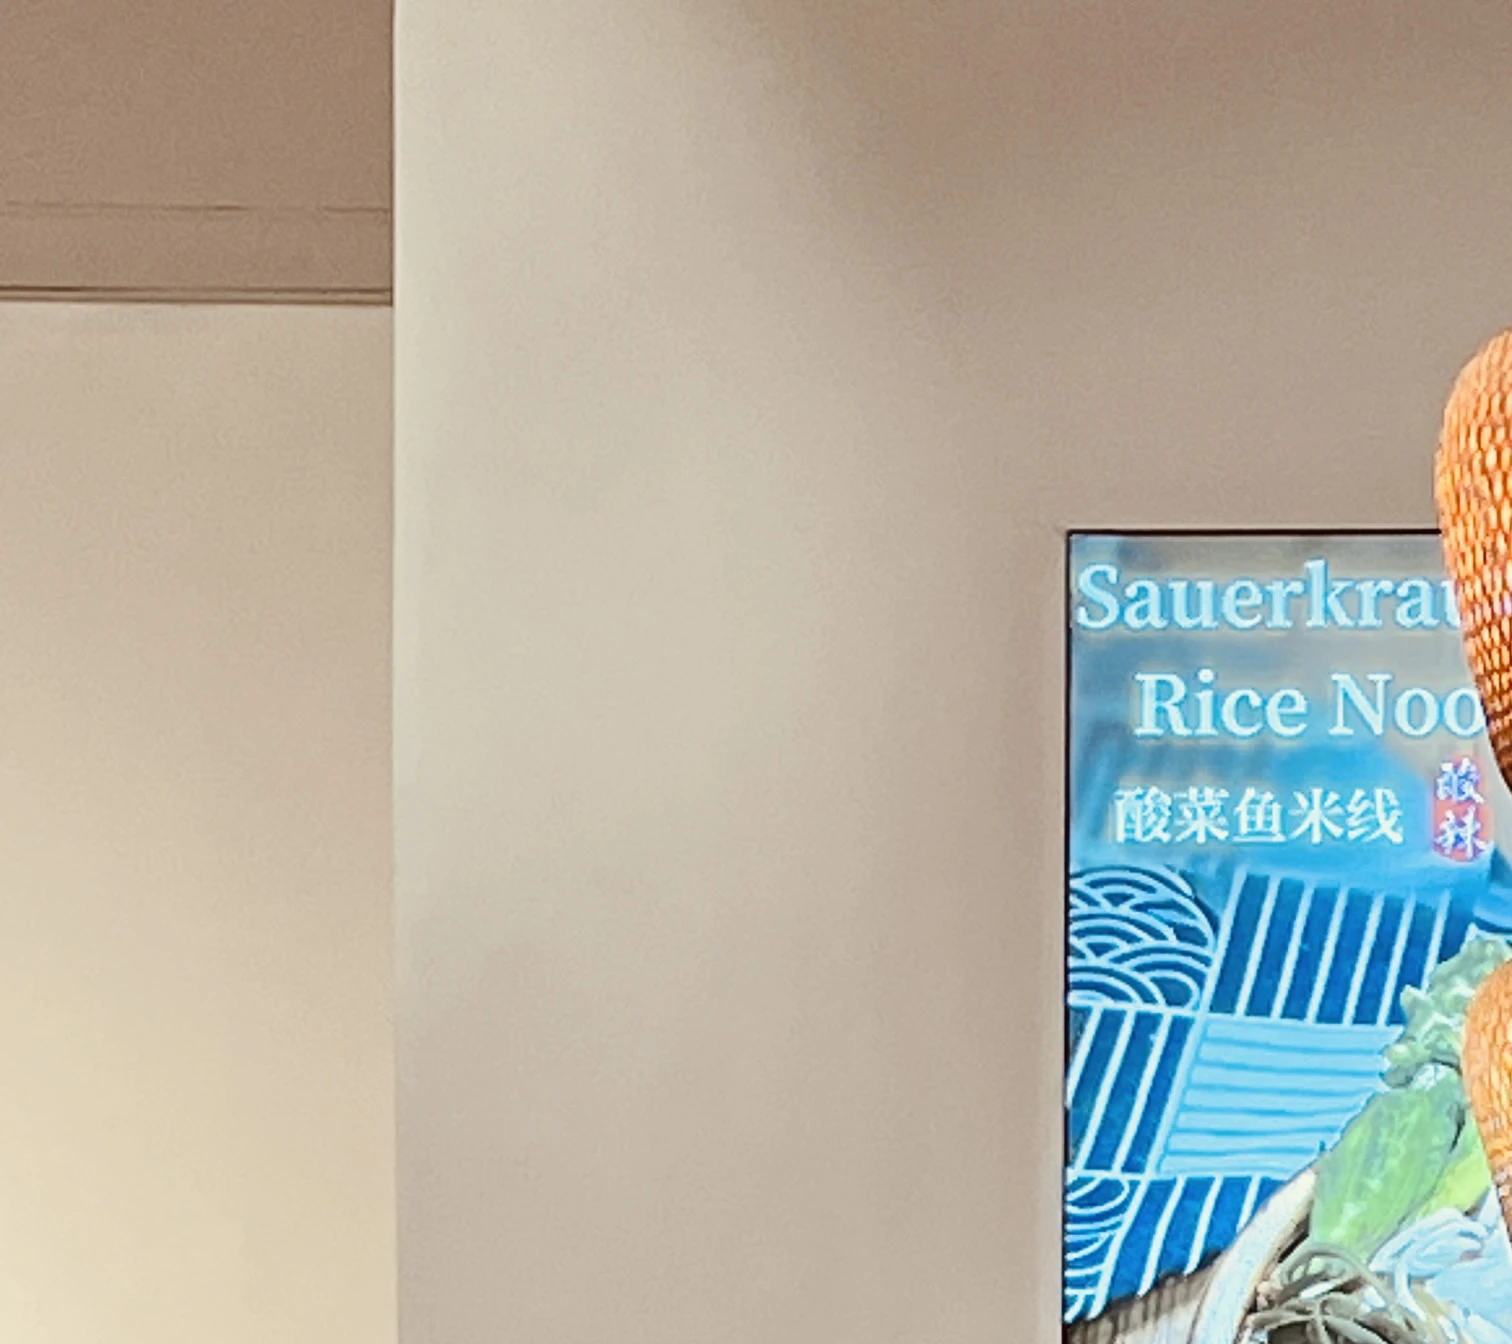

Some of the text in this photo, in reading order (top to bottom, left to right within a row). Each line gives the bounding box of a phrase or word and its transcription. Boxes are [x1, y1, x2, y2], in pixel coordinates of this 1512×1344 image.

[1133, 668, 1307, 737] Rice
[1113, 785, 1404, 844] 酸菜鱼米线
